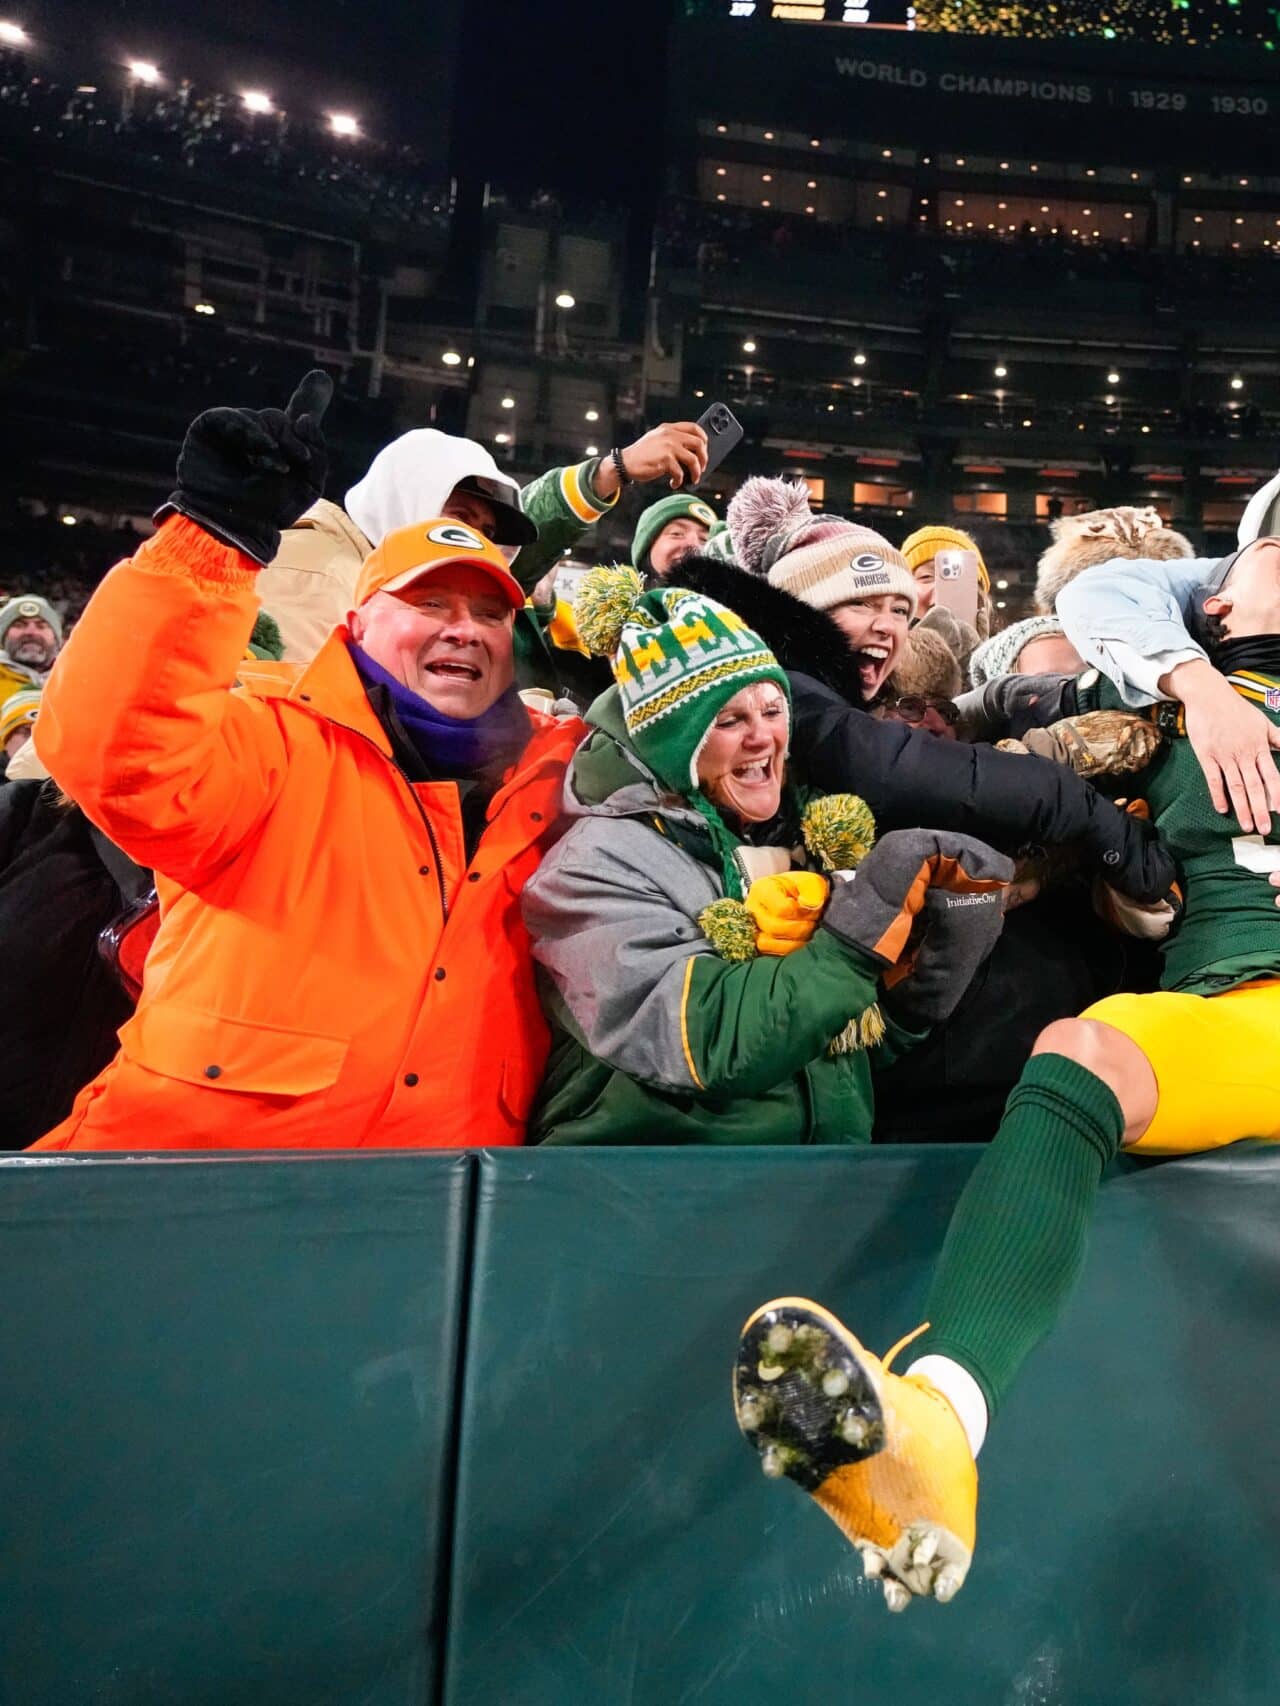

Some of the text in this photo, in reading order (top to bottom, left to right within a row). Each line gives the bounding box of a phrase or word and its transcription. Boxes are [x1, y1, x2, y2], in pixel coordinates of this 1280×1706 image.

[834, 57, 927, 88] WORLD
[939, 73, 1092, 104] CHAMPIONS
[1129, 90, 1186, 111] 1929
[1211, 95, 1268, 115] 1930
[426, 523, 485, 551] G
[849, 551, 885, 573] G
[853, 572, 891, 589] PACKERS
